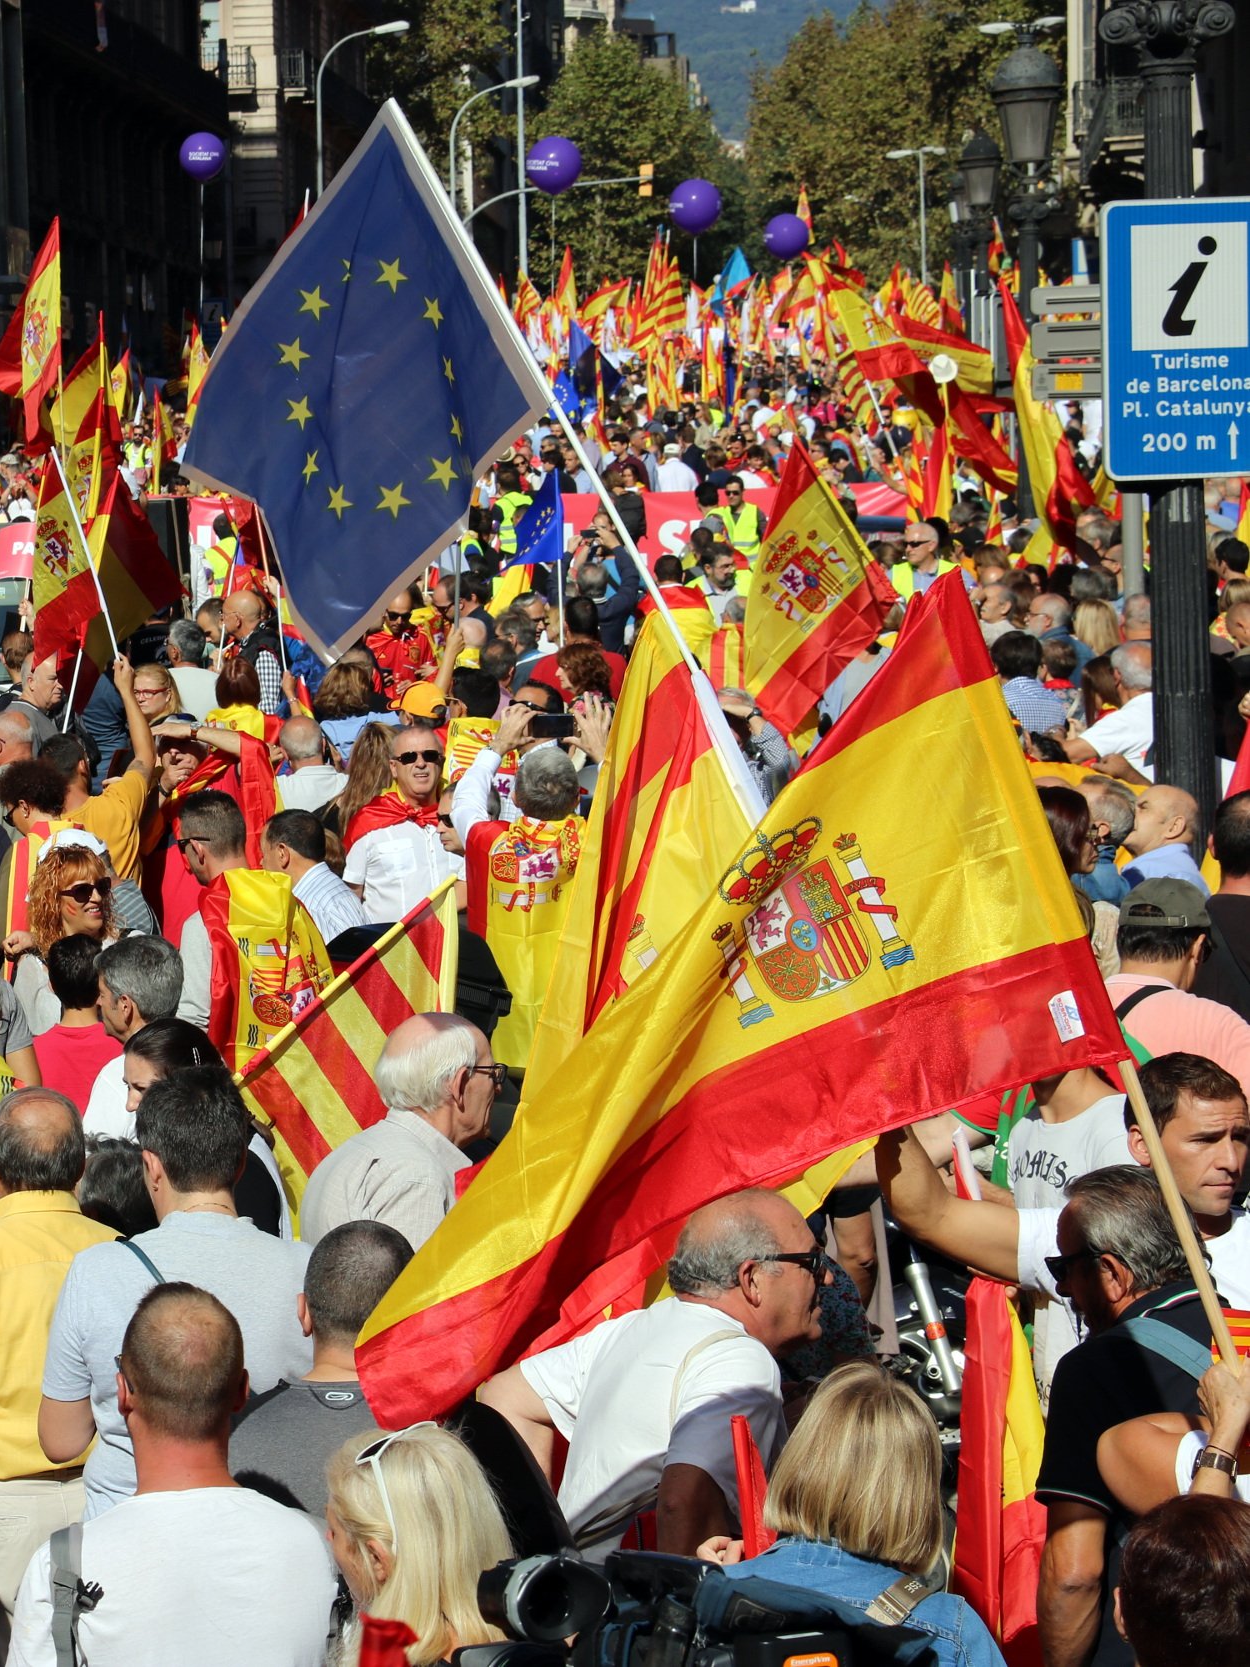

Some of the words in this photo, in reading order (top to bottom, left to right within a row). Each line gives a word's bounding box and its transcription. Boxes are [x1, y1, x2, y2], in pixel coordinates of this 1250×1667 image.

[1151, 353, 1229, 370] Turisme
[1126, 378, 1150, 394] de
[1122, 401, 1149, 418] Pl.
[1142, 432, 1187, 453] 200
[1196, 434, 1216, 450] m
